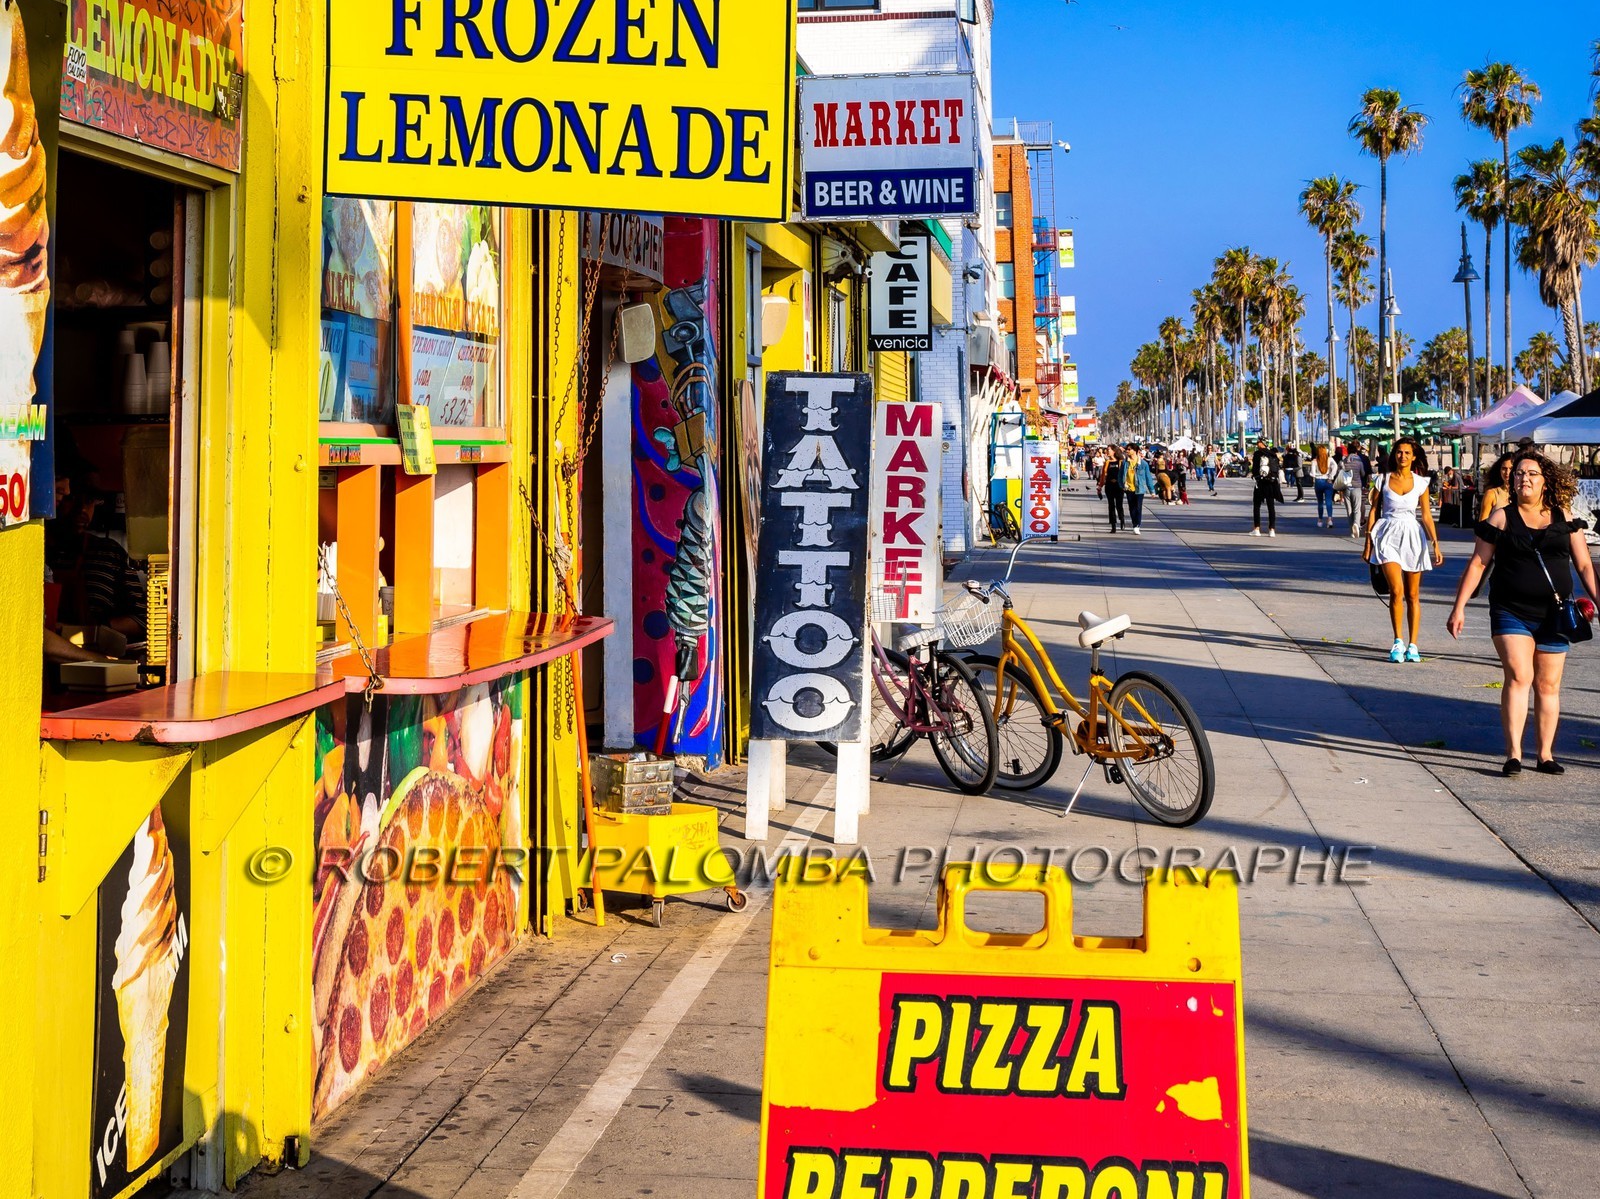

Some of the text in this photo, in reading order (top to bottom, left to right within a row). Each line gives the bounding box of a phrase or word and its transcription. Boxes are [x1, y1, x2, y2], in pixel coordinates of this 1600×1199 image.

[338, 91, 771, 184] LEMONADE
[813, 99, 964, 148] MARKET
[814, 178, 964, 207] BEER & WINE
[885, 239, 921, 329] CAFE
[874, 337, 929, 350] venicia
[0, 404, 47, 441] EAM
[883, 404, 933, 619] MARKET
[1029, 456, 1052, 534] TATTOO
[762, 377, 860, 733] TATTOO
[885, 994, 1126, 1099] PIZZA
[96, 1080, 129, 1188] ICE
